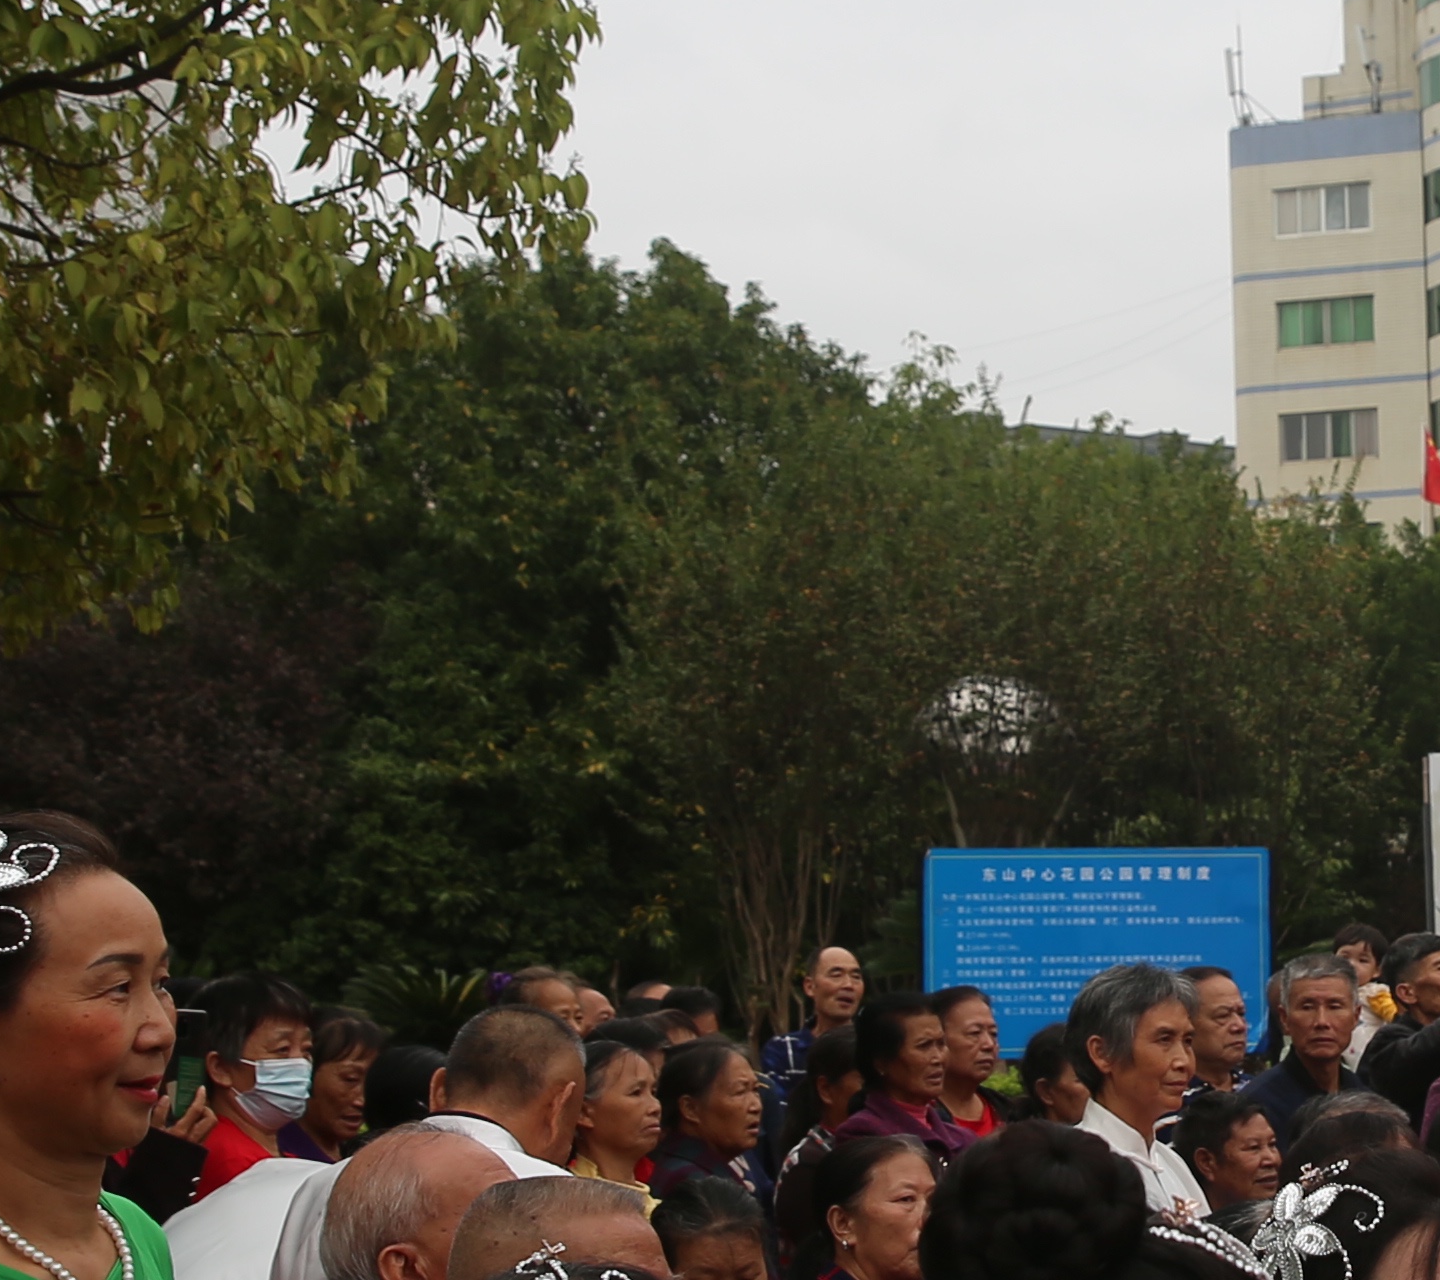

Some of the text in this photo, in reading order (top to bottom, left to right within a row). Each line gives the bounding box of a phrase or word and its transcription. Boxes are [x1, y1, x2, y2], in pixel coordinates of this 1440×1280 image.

[982, 865, 1211, 883] 东山中心花园公园管理制度
